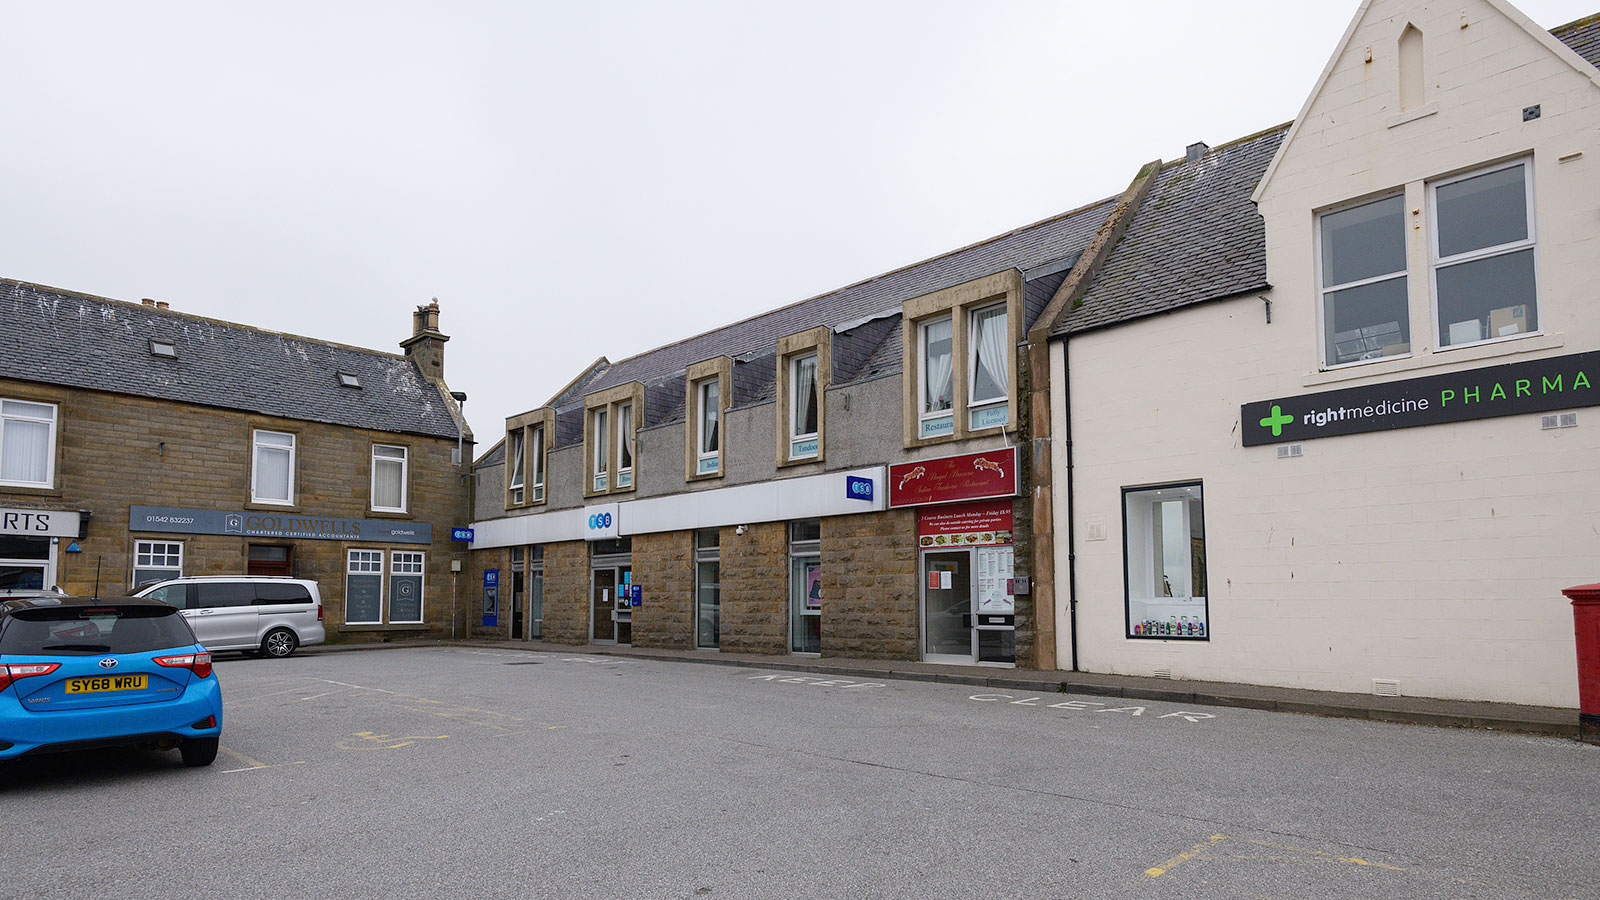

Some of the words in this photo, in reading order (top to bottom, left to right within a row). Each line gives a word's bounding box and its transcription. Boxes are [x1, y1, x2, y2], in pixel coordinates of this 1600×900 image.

[1303, 398, 1429, 427] rightmedicine
[1441, 371, 1591, 408] PHARMA
[3, 512, 50, 531] RTS
[146, 515, 168, 523] 01542
[169, 516, 195, 524] 832237
[246, 515, 361, 535] GOLDWELLS
[590, 514, 611, 528] TSB
[71, 679, 110, 692] SY68
[114, 676, 142, 690] WRU
[746, 674, 887, 688] KEEP
[968, 693, 1217, 723] CLEAR
